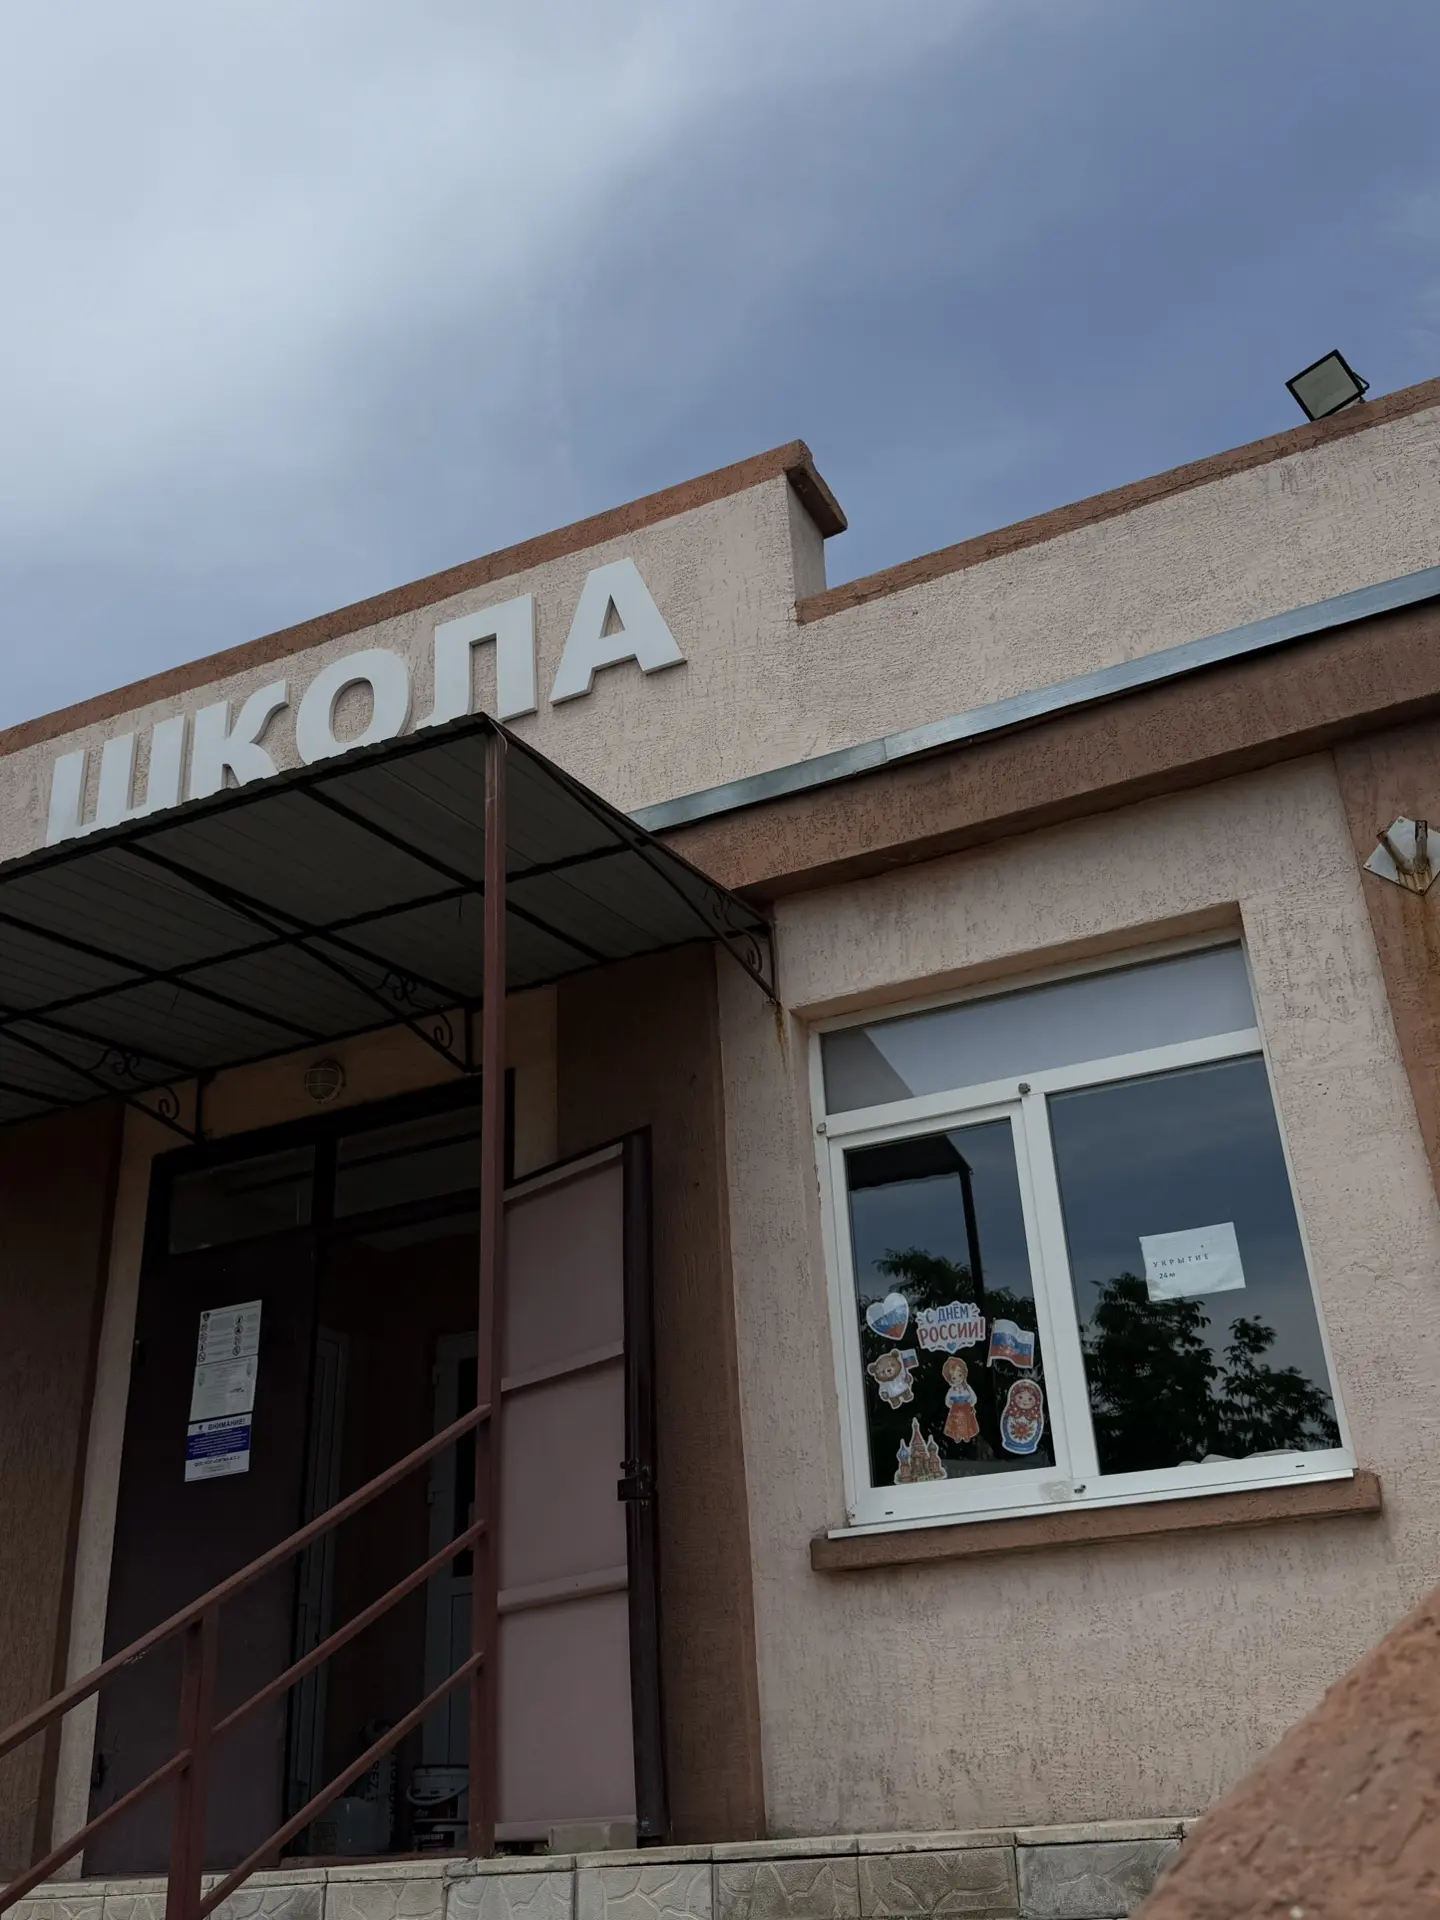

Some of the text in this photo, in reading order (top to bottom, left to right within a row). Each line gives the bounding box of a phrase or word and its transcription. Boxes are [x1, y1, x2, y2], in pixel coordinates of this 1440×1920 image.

[46, 557, 687, 845] ШКОЛА
[1152, 1253, 1209, 1268] УКРЫТИЕ
[925, 1303, 969, 1324] С ДНЁМ
[919, 1318, 984, 1346] РОССИИ!
